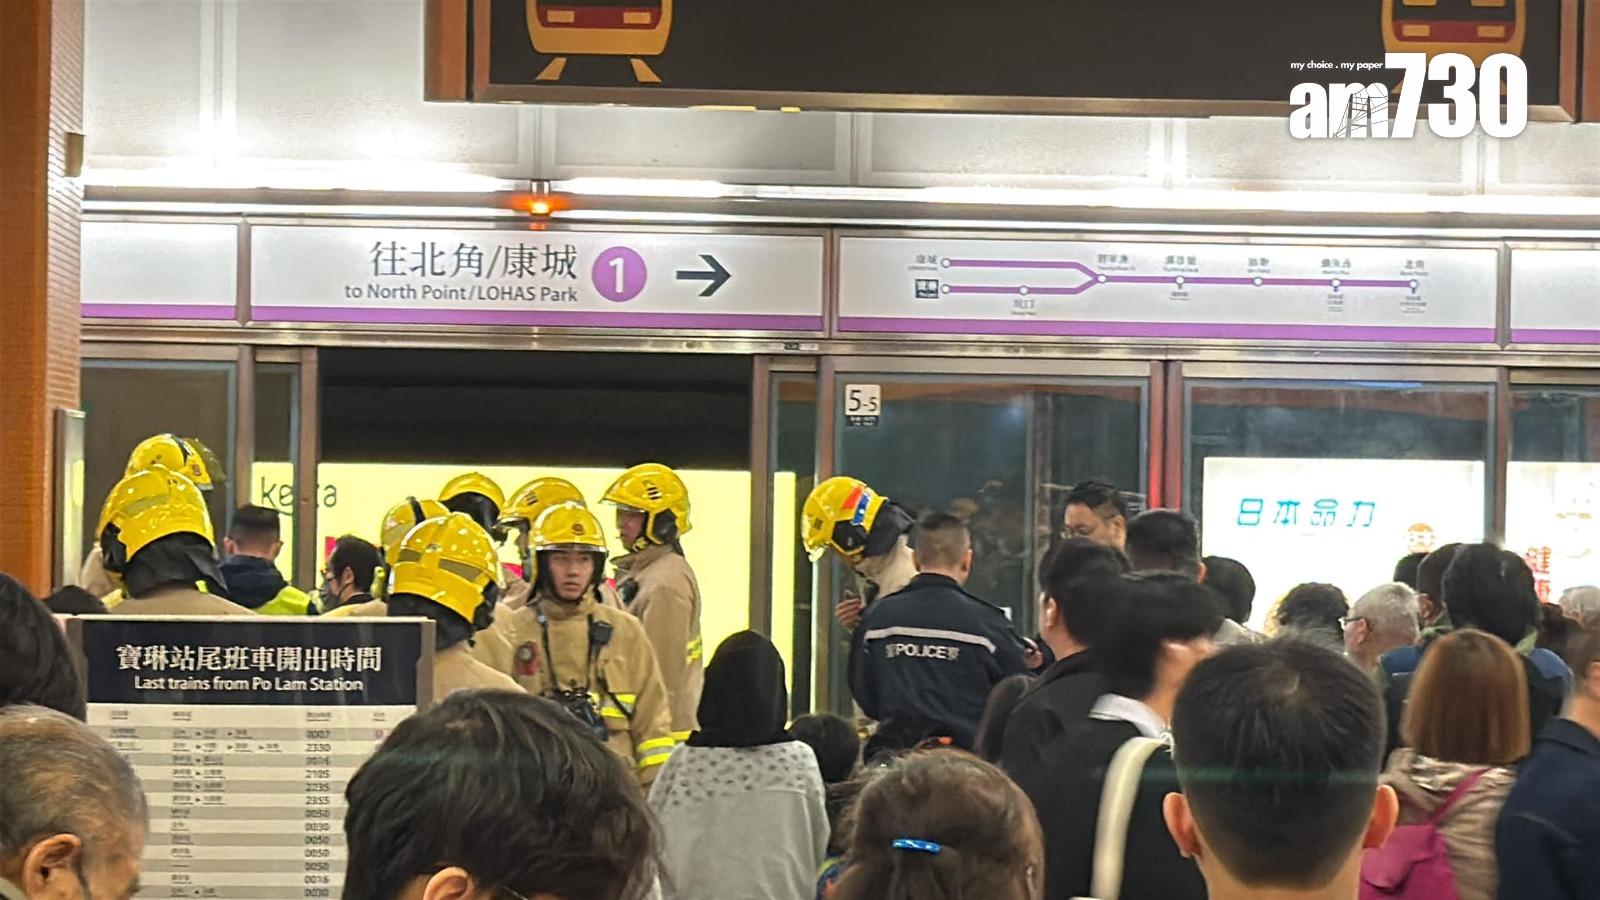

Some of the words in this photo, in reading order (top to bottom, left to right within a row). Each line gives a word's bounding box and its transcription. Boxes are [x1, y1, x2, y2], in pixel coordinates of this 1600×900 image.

[369, 240, 578, 280] 往北角/康城
[608, 256, 624, 294] 1
[344, 285, 363, 298] to
[367, 284, 417, 299] North
[421, 284, 536, 301] Point/LOHAS
[541, 287, 578, 302] Park
[115, 644, 383, 673] 寶琳站尾班車開出時間
[134, 675, 165, 690] Last
[167, 676, 211, 690] trains
[213, 676, 250, 690] from
[252, 676, 272, 691] Po
[274, 677, 307, 691] Lam
[309, 677, 364, 691] Station
[305, 743, 331, 752] 2330
